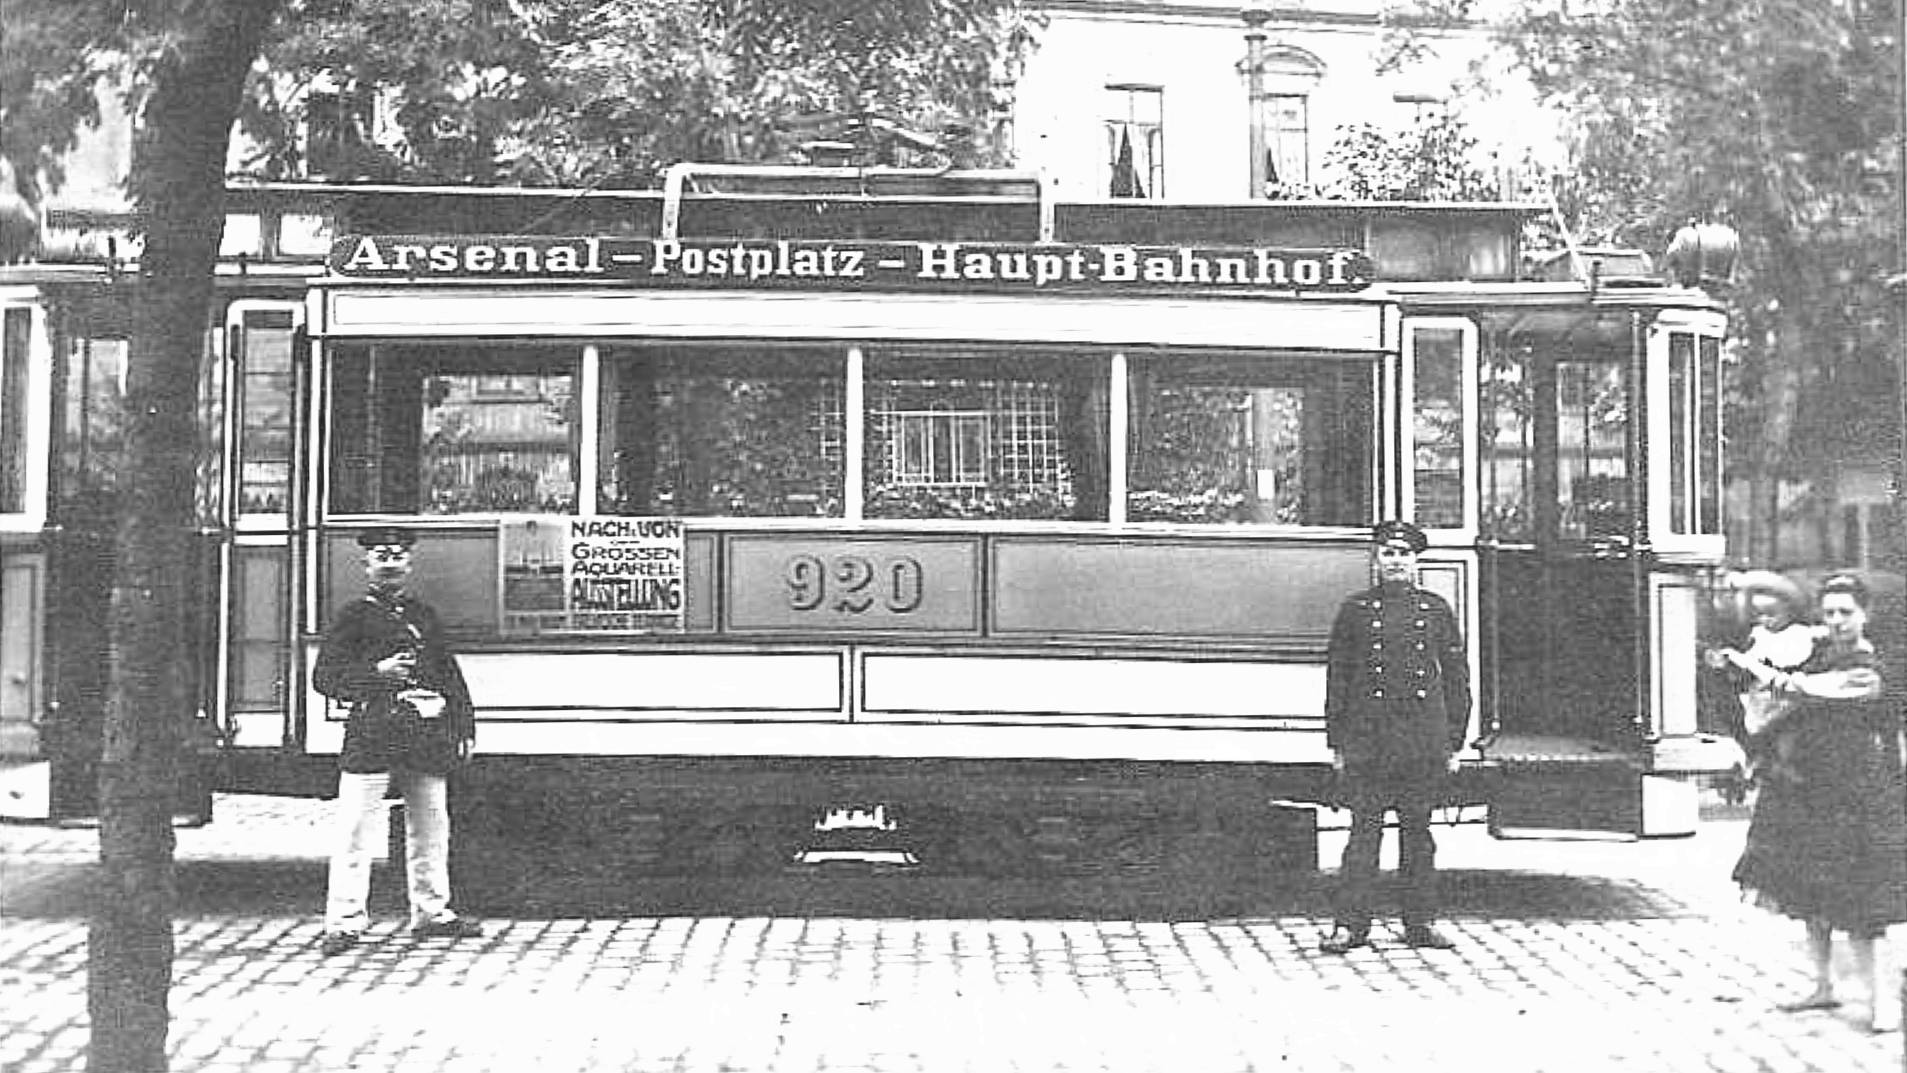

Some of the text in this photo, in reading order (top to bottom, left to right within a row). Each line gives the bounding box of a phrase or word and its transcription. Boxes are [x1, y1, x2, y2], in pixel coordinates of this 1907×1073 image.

[346, 236, 603, 273] Arsenal
[652, 239, 865, 280] Postplatz
[571, 520, 630, 538] NACH
[571, 542, 680, 560] GROSSEN
[787, 555, 924, 614] 920
